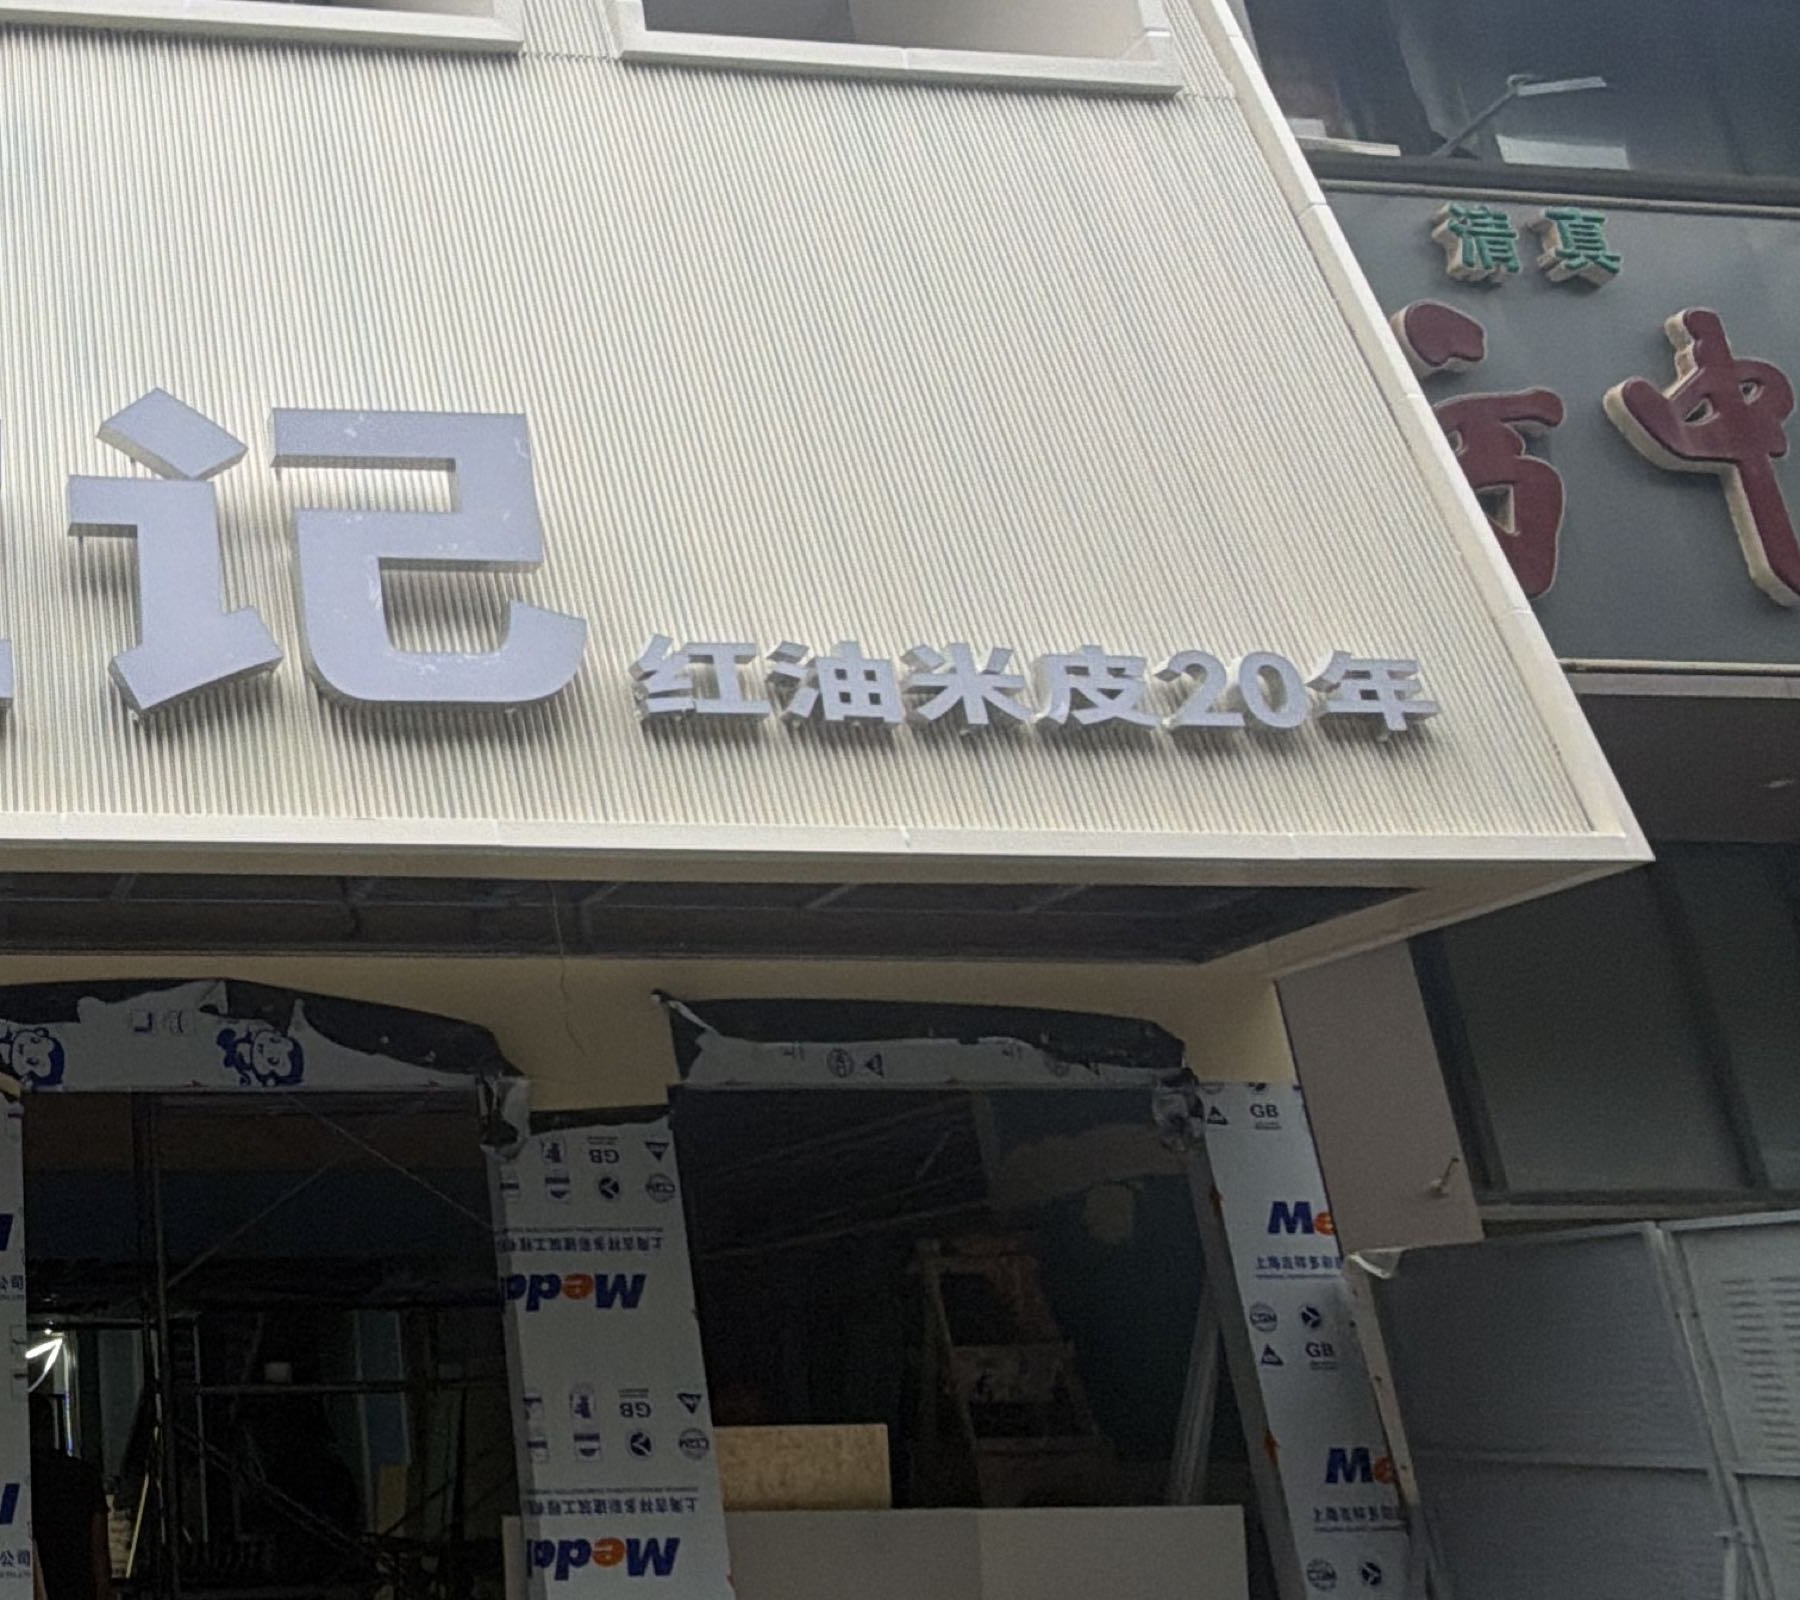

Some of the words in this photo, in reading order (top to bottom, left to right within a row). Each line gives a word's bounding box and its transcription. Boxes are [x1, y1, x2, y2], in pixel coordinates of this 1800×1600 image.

[1436, 201, 1623, 284] 清真
[630, 634, 1440, 734] 红油米皮20年
[1250, 1104, 1279, 1119] GB
[1305, 1343, 1334, 1358] GB
[620, 1402, 652, 1418] GB
